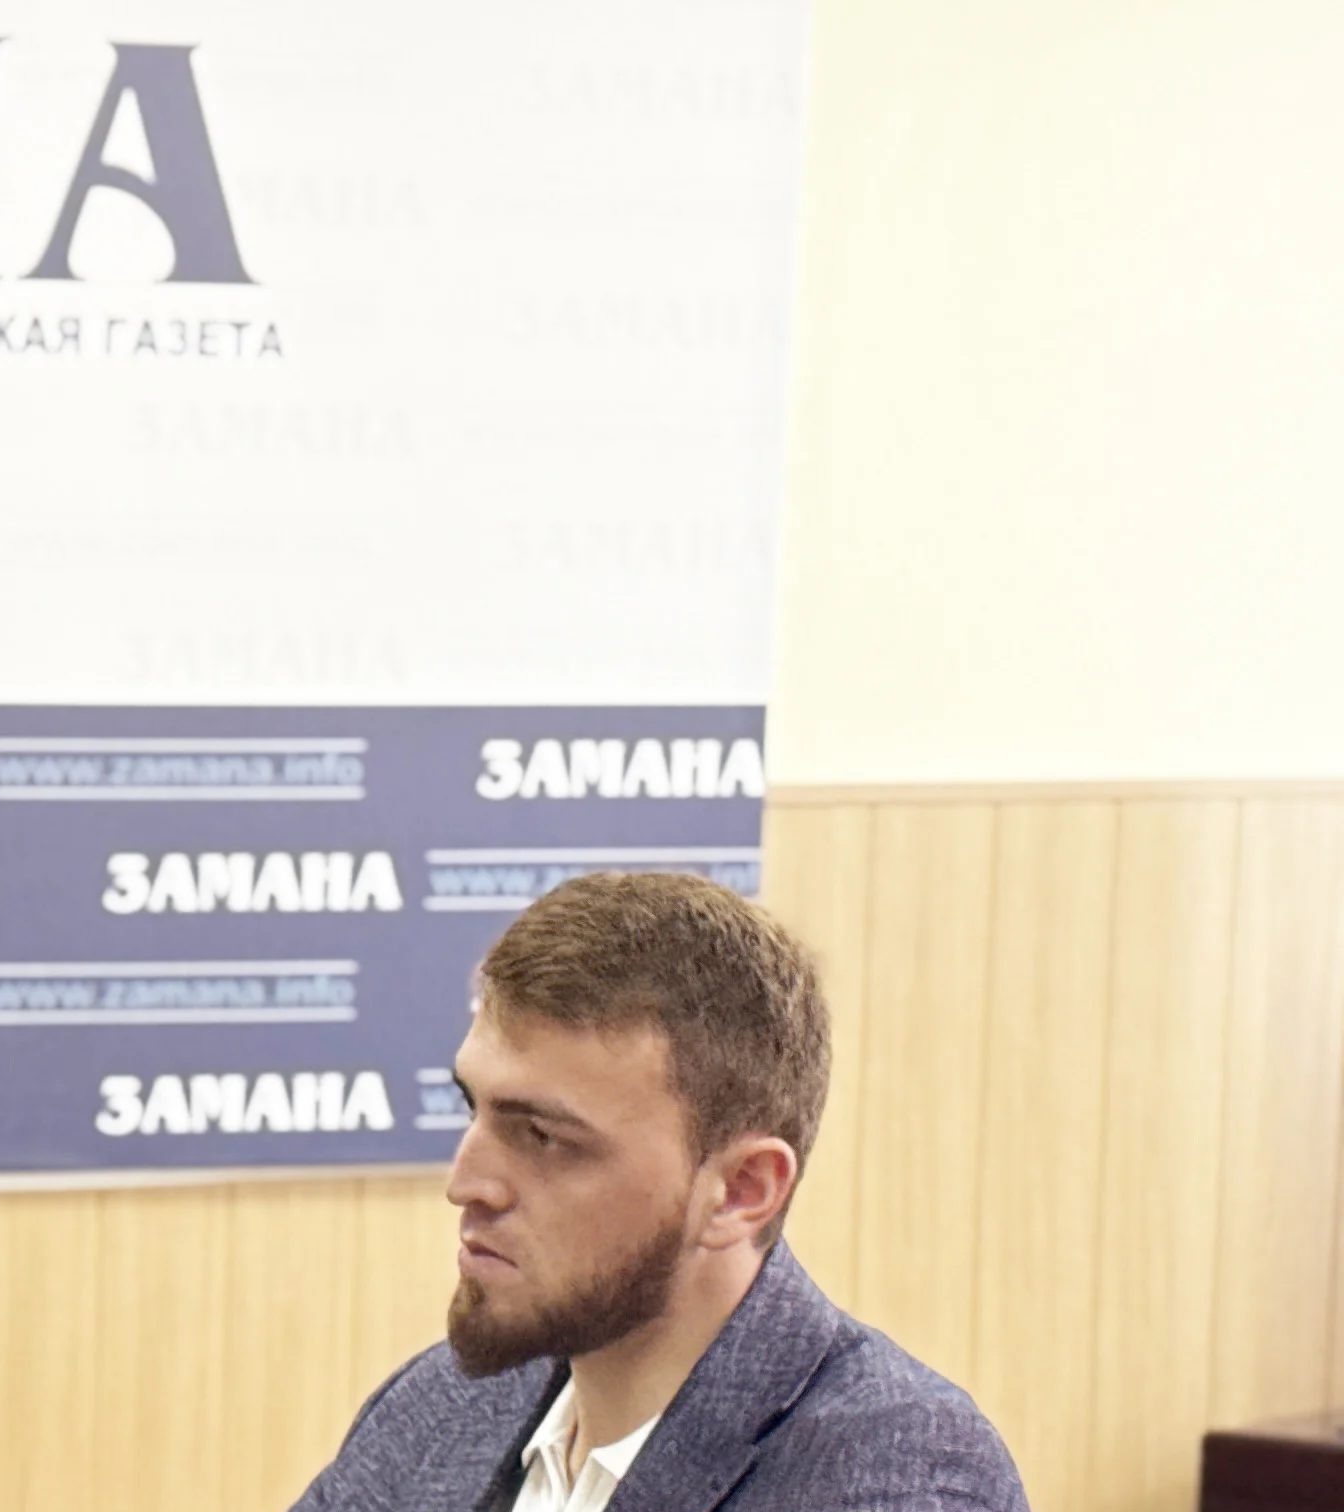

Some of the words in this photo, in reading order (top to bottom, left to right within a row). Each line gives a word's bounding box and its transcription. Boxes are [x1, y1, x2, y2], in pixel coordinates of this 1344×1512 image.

[106, 317, 285, 358] ГАЗЕТА
[475, 737, 764, 801] ЗАМАНА
[102, 851, 403, 914] ЗАМАНА
[96, 1071, 394, 1136] ЗАМАНА
